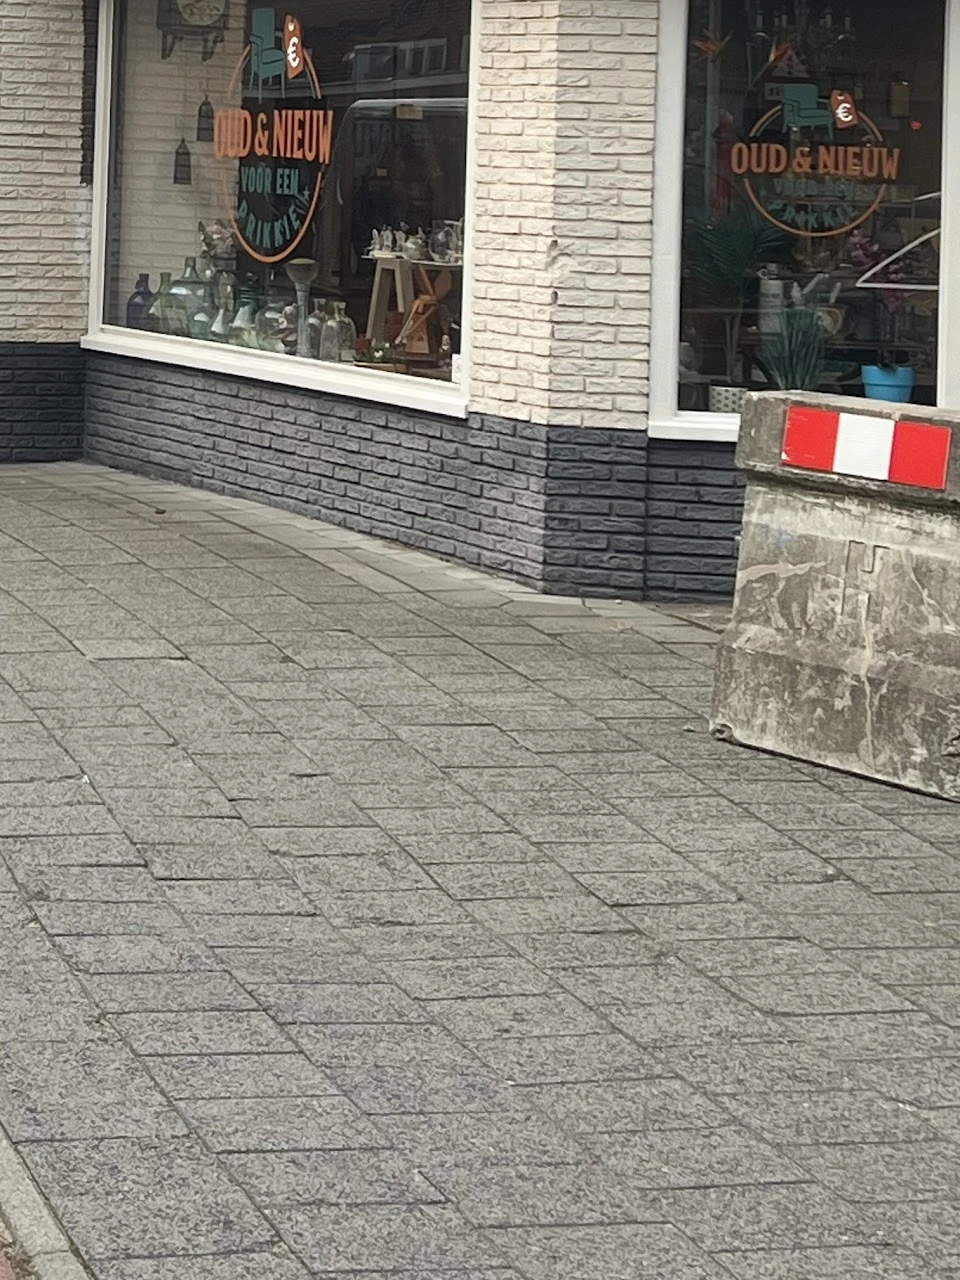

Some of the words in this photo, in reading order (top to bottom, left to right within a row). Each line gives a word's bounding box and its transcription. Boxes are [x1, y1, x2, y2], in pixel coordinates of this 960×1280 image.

[213, 108, 252, 160] OUD
[254, 112, 268, 156] &
[272, 109, 333, 164] NIEUW
[241, 166, 271, 193] VOOR
[276, 168, 299, 195] EEN
[730, 143, 787, 174] OUD
[792, 147, 811, 173] &
[818, 146, 900, 180] NIEUW
[237, 200, 301, 249] PRIKKIE
